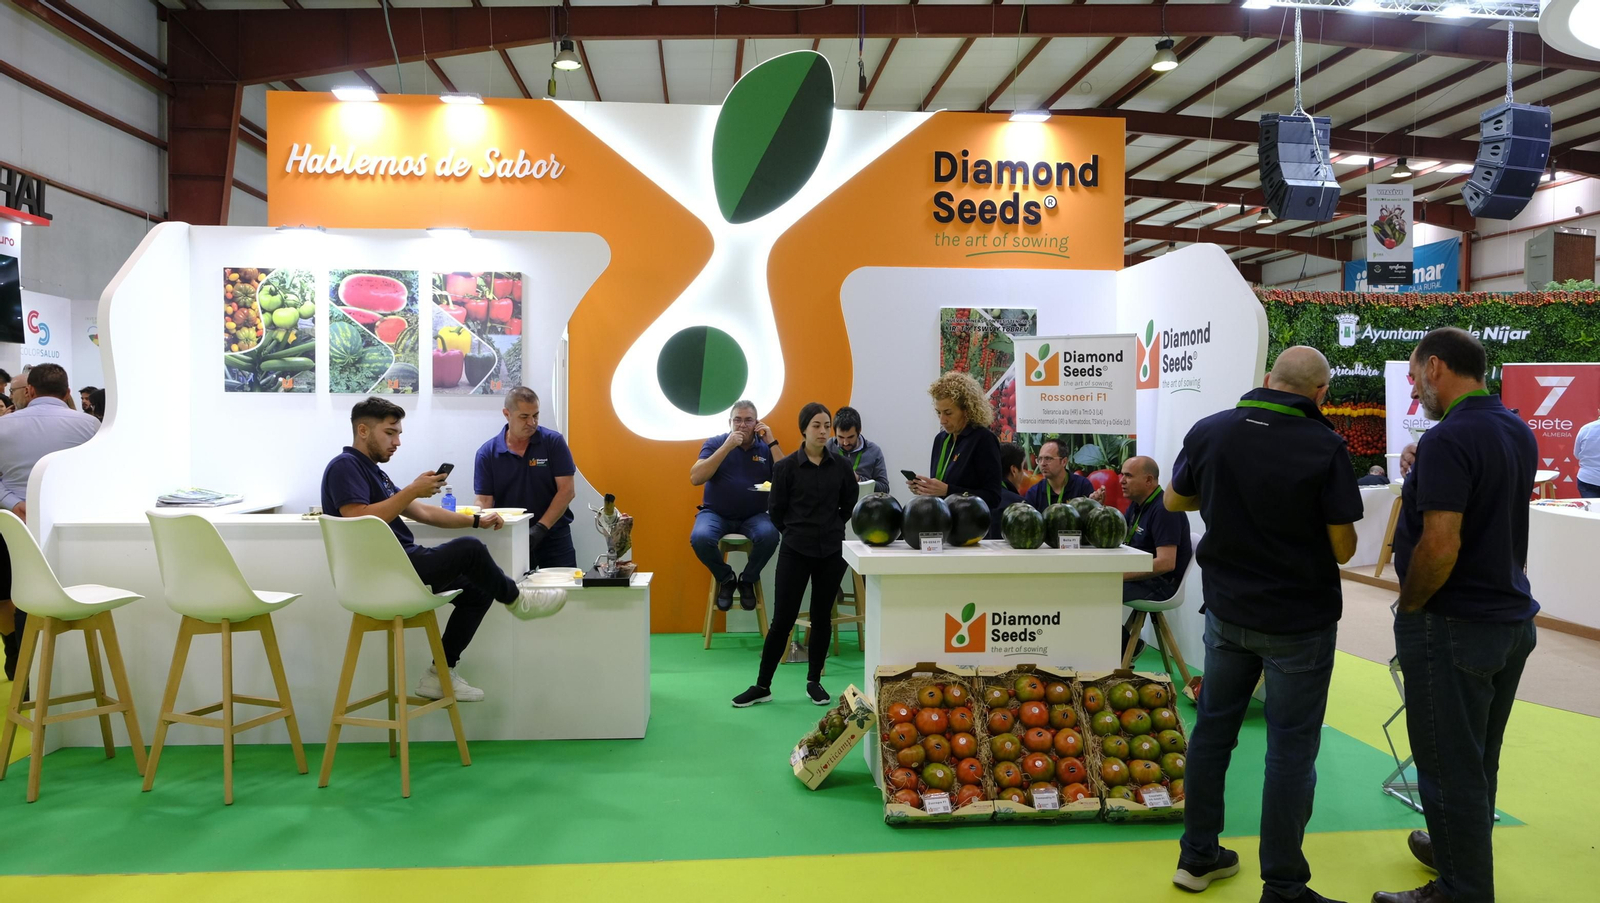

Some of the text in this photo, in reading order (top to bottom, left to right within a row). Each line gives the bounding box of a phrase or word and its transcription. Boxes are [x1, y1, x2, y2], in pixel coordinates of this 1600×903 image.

[285, 143, 566, 179] Hablemos de Sabor
[934, 149, 1098, 187] Diamond
[934, 232, 1069, 253] the art of sowing
[1163, 321, 1211, 349] Diamond
[1361, 323, 1429, 344] Ayuntami
[1483, 325, 1531, 344] Níjar
[1063, 350, 1123, 363] Diamond
[1330, 363, 1380, 378] gricultura
[1162, 377, 1201, 389] the art of sowing
[1040, 392, 1107, 402] Rossoneri F1
[1528, 418, 1573, 430] siete
[991, 611, 1061, 626] Diamond
[991, 645, 1002, 653] the
[1015, 645, 1023, 653] of
[1023, 645, 1048, 654] sowing
